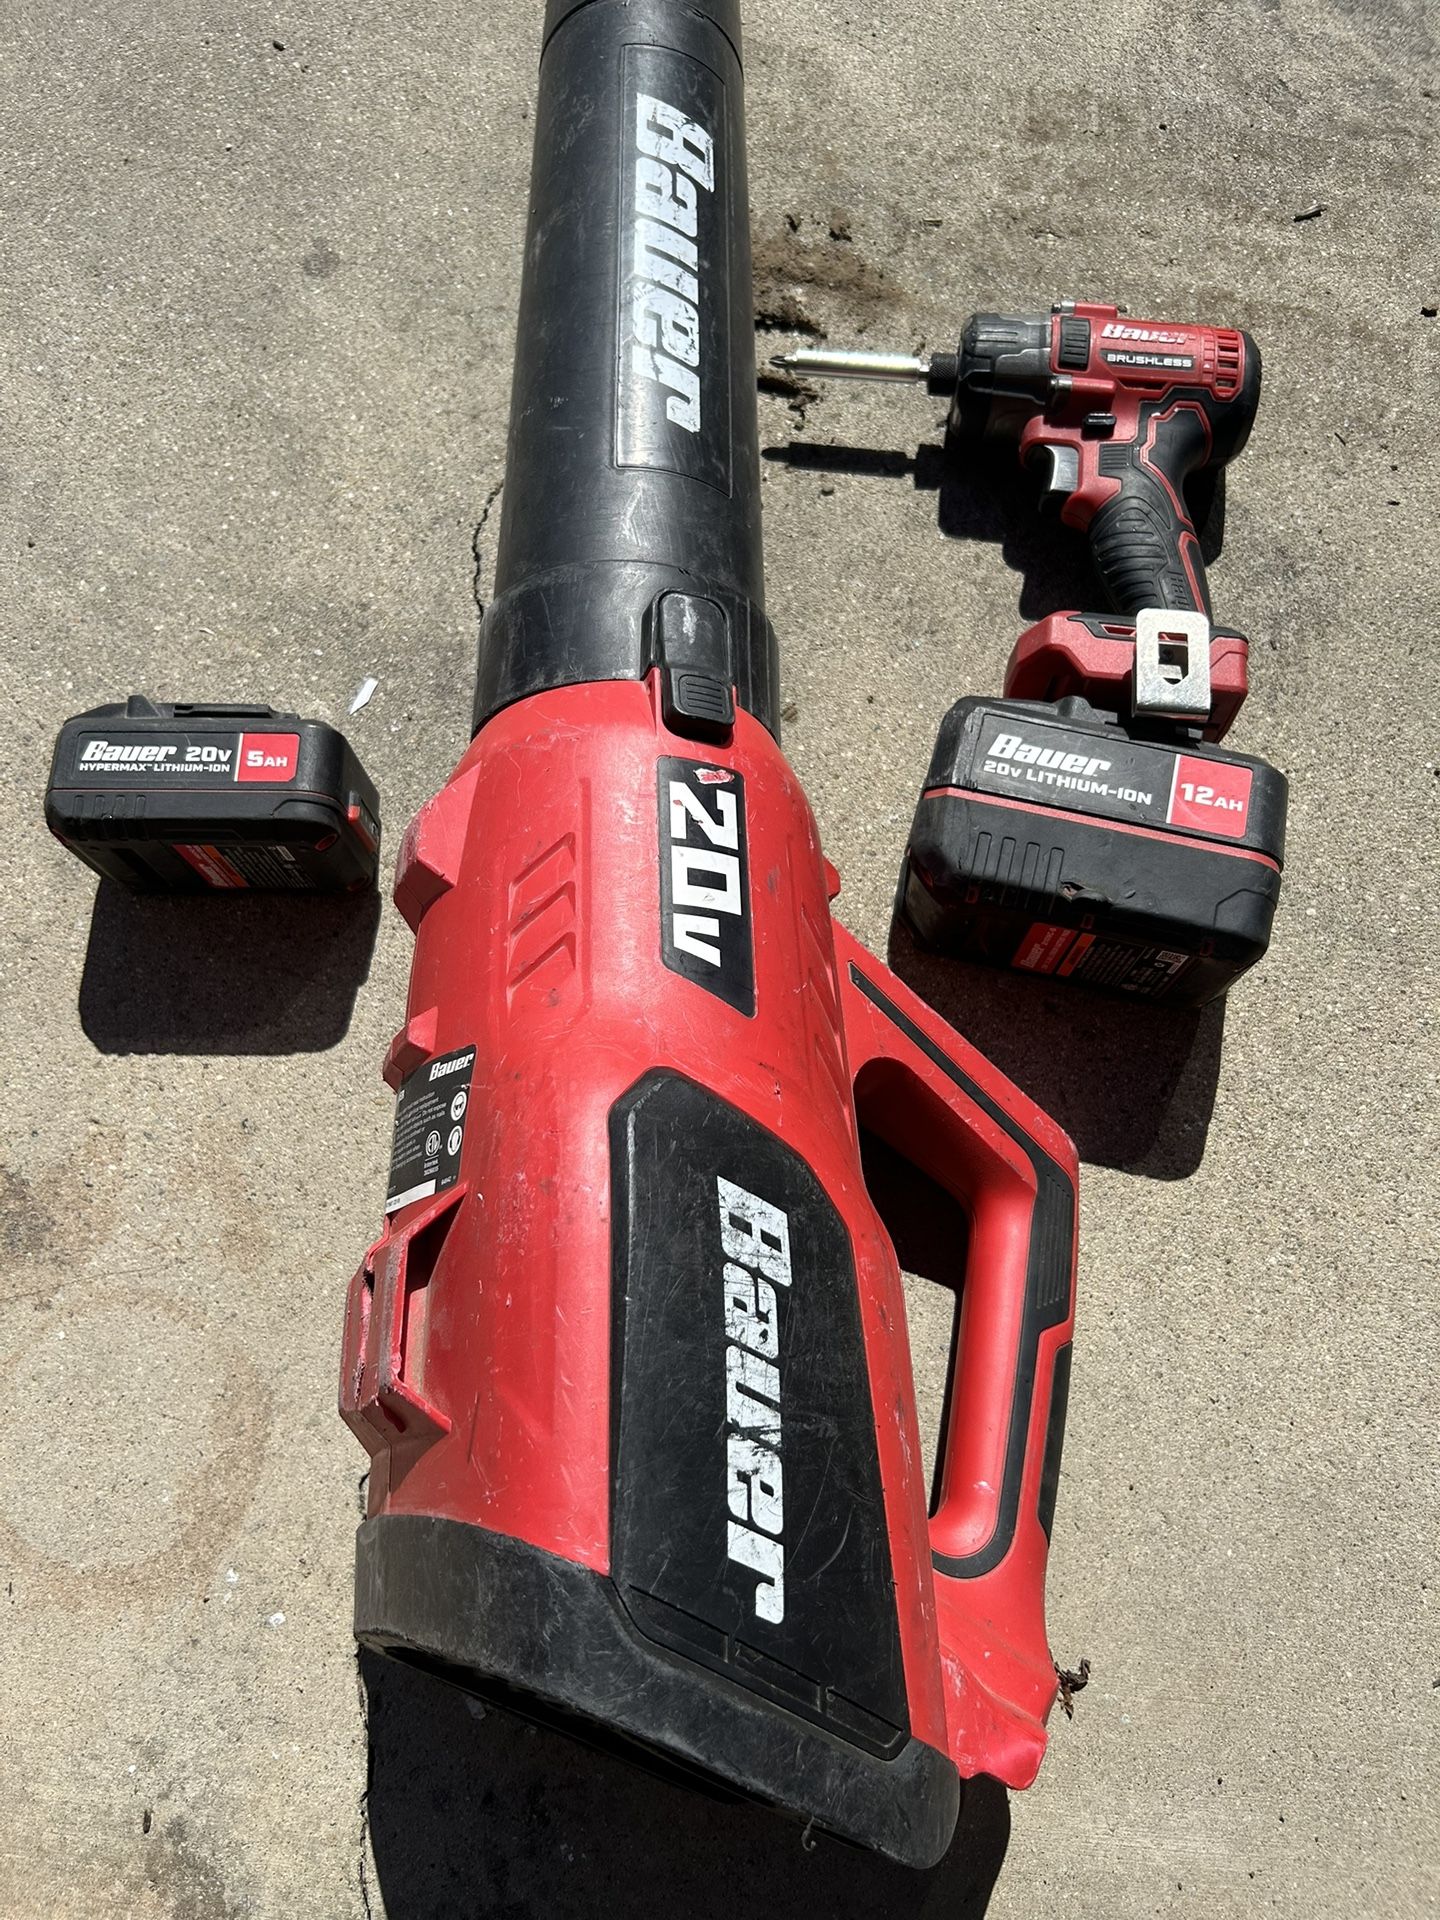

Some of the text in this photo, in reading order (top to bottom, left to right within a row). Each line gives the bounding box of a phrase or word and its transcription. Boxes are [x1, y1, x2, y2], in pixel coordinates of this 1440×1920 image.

[632, 92, 715, 433] Bauer
[1101, 323, 1196, 345] Bauer
[1107, 353, 1192, 368] BRUSHLESS
[81, 740, 177, 762] Bauer
[987, 733, 1111, 778] Bauer
[154, 763, 231, 773] LITHIUM-ION
[1026, 768, 1152, 806] LITHIUM-ION
[429, 1053, 475, 1082] Bauer
[716, 1175, 793, 1625] Bauer
